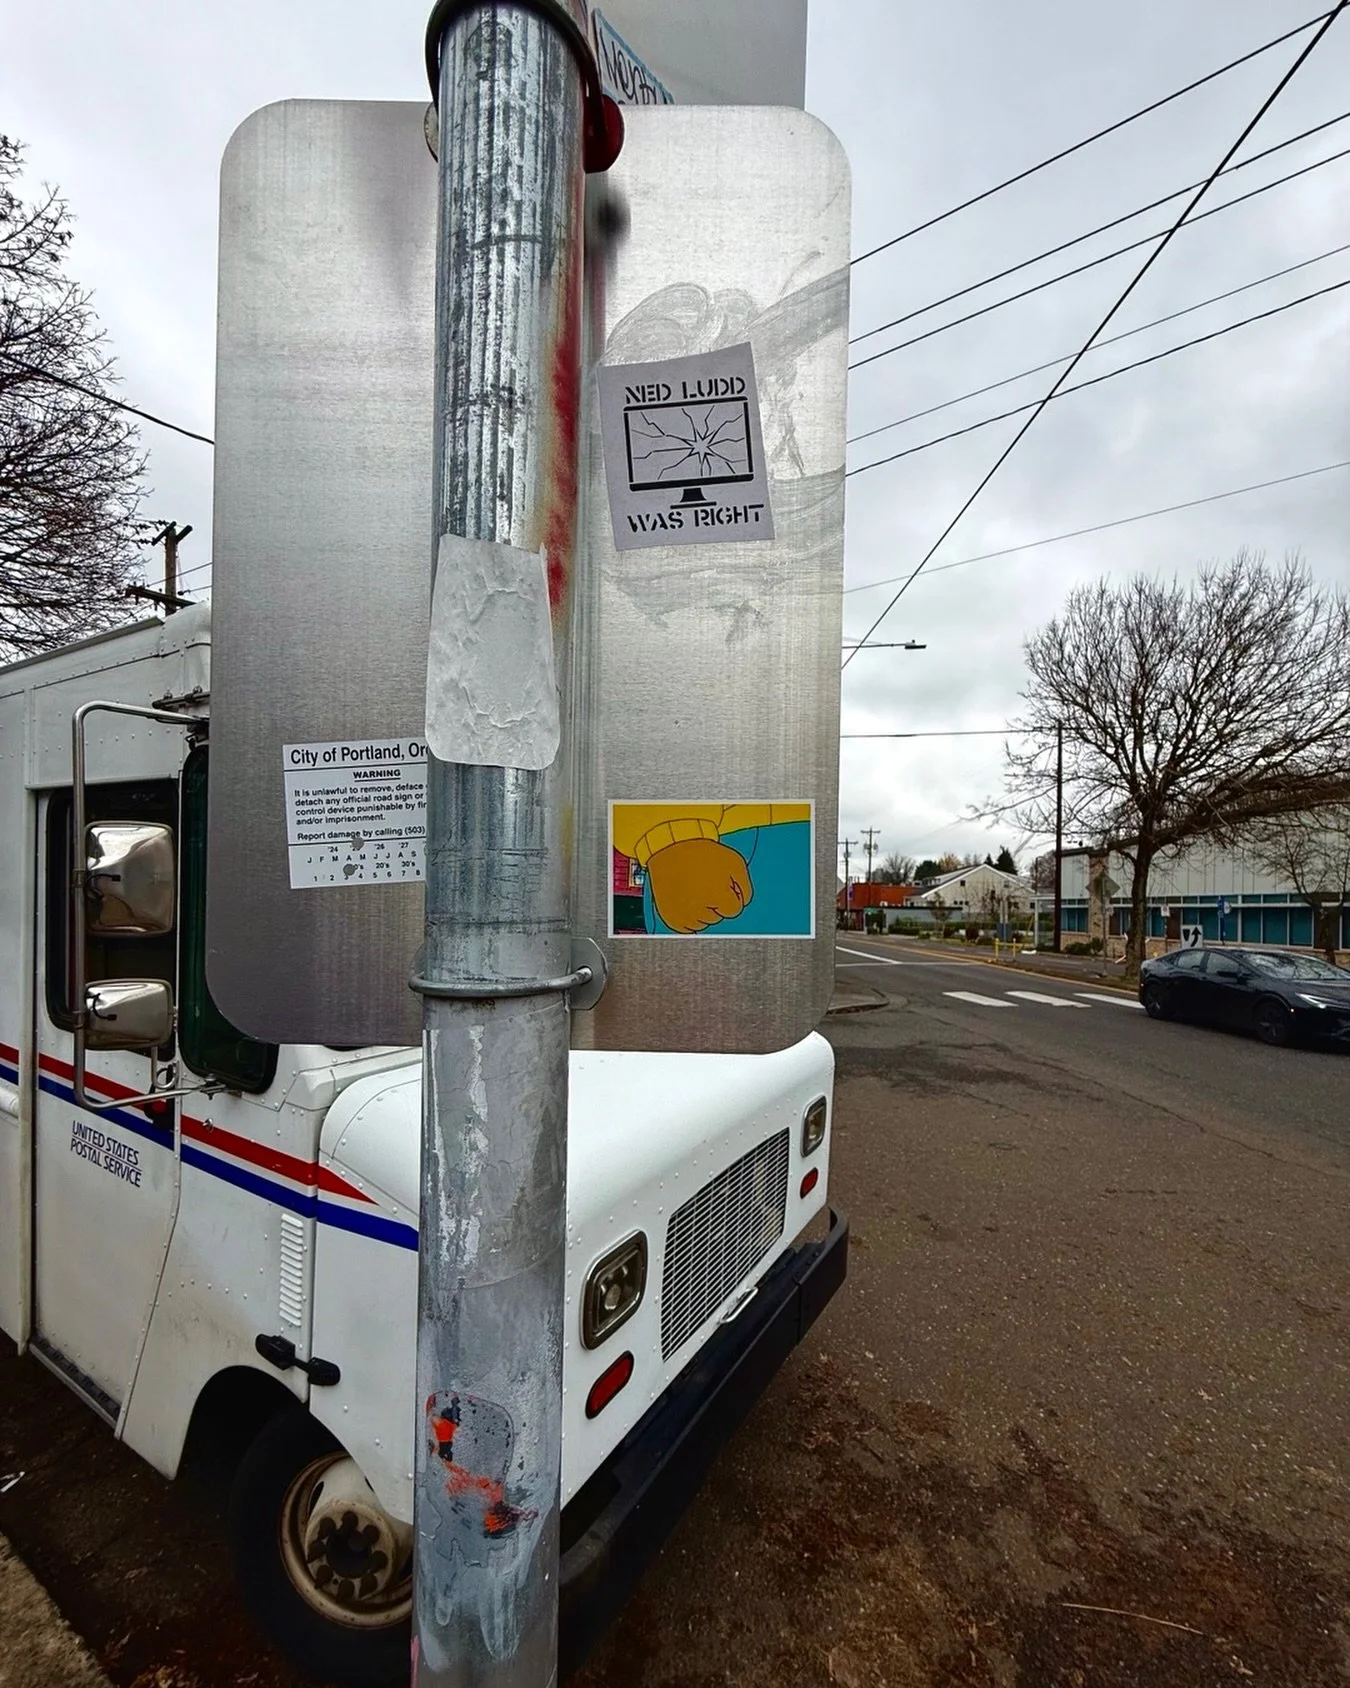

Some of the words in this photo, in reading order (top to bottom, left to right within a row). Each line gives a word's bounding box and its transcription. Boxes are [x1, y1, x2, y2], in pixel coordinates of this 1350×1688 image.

[625, 383, 671, 404] NED
[682, 377, 746, 399] LUDD
[627, 511, 683, 533] WAS
[694, 504, 764, 527] RIGHT
[291, 749, 318, 767] City
[323, 747, 337, 762] of
[341, 744, 405, 761] Portland,
[353, 769, 401, 779] WARNING
[294, 789, 300, 797] It
[312, 787, 347, 796] unlawful
[360, 785, 394, 793] remove,
[395, 783, 424, 791] deface
[295, 798, 323, 806] detach
[343, 795, 371, 804] official
[394, 793, 413, 802] sign
[296, 807, 325, 816] control
[327, 806, 355, 814] device
[357, 803, 403, 814] punishable
[405, 803, 415, 811] by
[296, 817, 323, 825] and/or
[325, 814, 385, 824] imprisonment.
[297, 832, 326, 841] Report
[327, 830, 361, 839] damage
[363, 829, 373, 838] by
[375, 828, 403, 836] calling
[404, 825, 426, 835] (503)
[72, 1120, 105, 1148] UNITED
[105, 1137, 139, 1165] STATES
[70, 1138, 102, 1167] POSTAL
[103, 1155, 142, 1188] SERVICE
